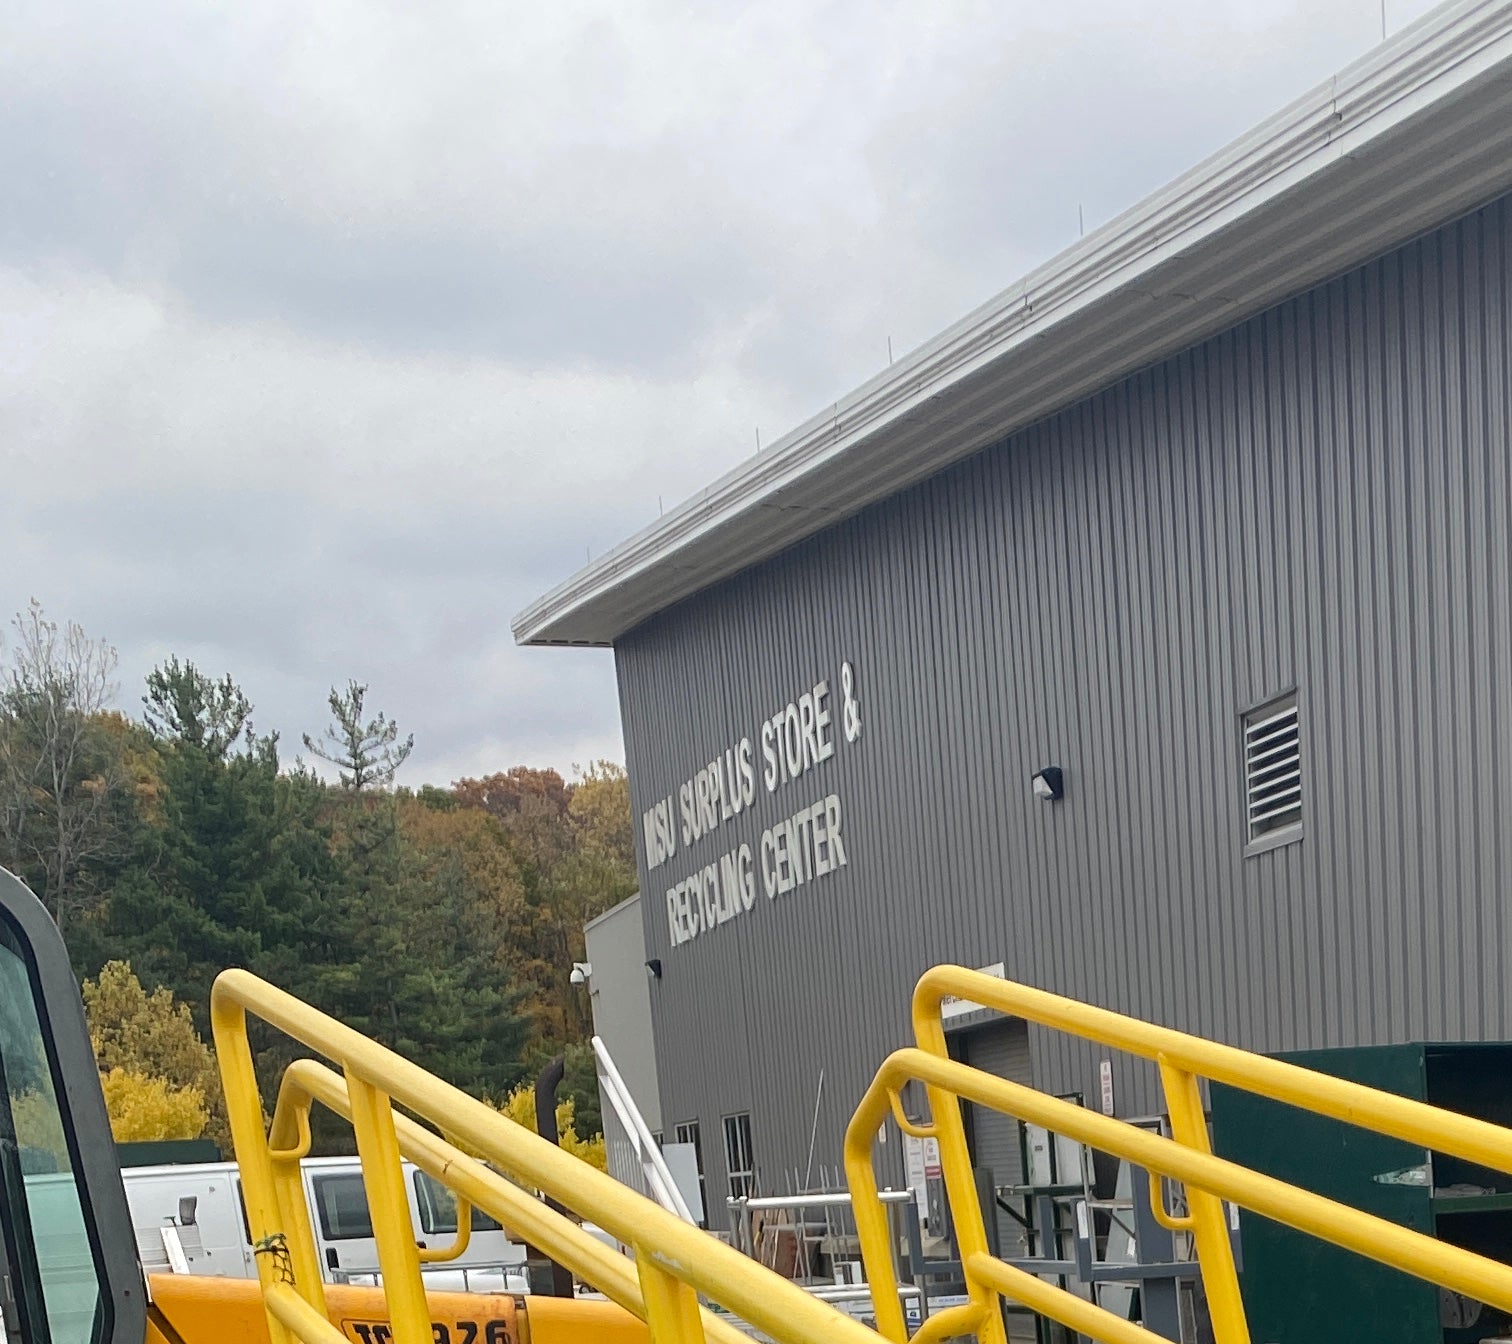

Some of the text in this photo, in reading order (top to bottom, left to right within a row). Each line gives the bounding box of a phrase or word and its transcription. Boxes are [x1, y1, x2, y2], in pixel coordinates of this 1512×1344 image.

[643, 661, 863, 870] MSU SURPLUS STORE &
[666, 794, 848, 947] RECYCLING CENTER
